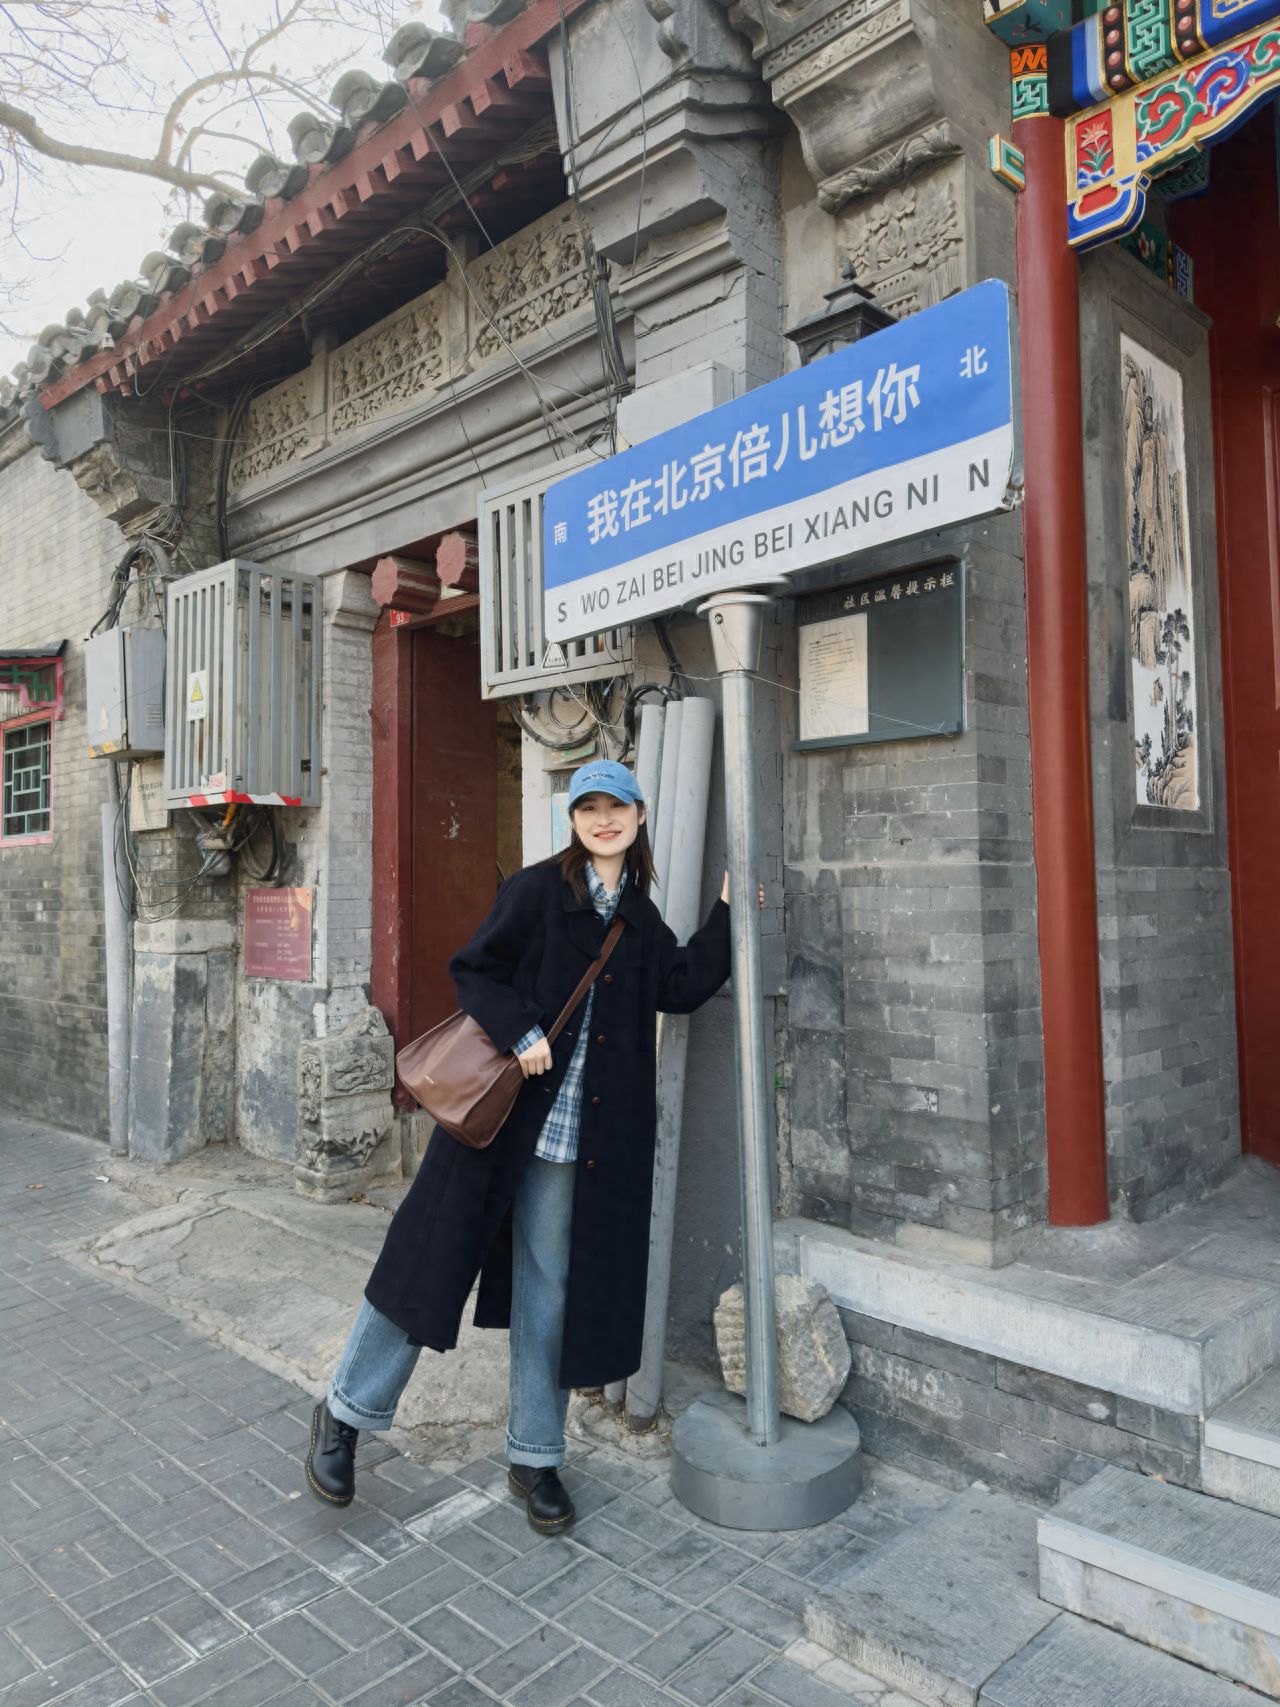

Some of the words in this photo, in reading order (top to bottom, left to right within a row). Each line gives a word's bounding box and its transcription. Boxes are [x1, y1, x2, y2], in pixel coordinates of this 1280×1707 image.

[554, 521, 568, 545] 南
[587, 362, 921, 545] 我在北京倍儿想你
[959, 345, 989, 379] 北
[557, 602, 568, 623] S
[581, 588, 610, 615] WO
[616, 573, 645, 605] ZAI
[653, 560, 683, 592] BEI
[692, 540, 744, 578] JING
[755, 523, 793, 559] BEI
[804, 490, 893, 545] XIANG
[907, 474, 939, 510] NI
[969, 458, 990, 492] N
[844, 572, 955, 609] 社区温馨提示栏
